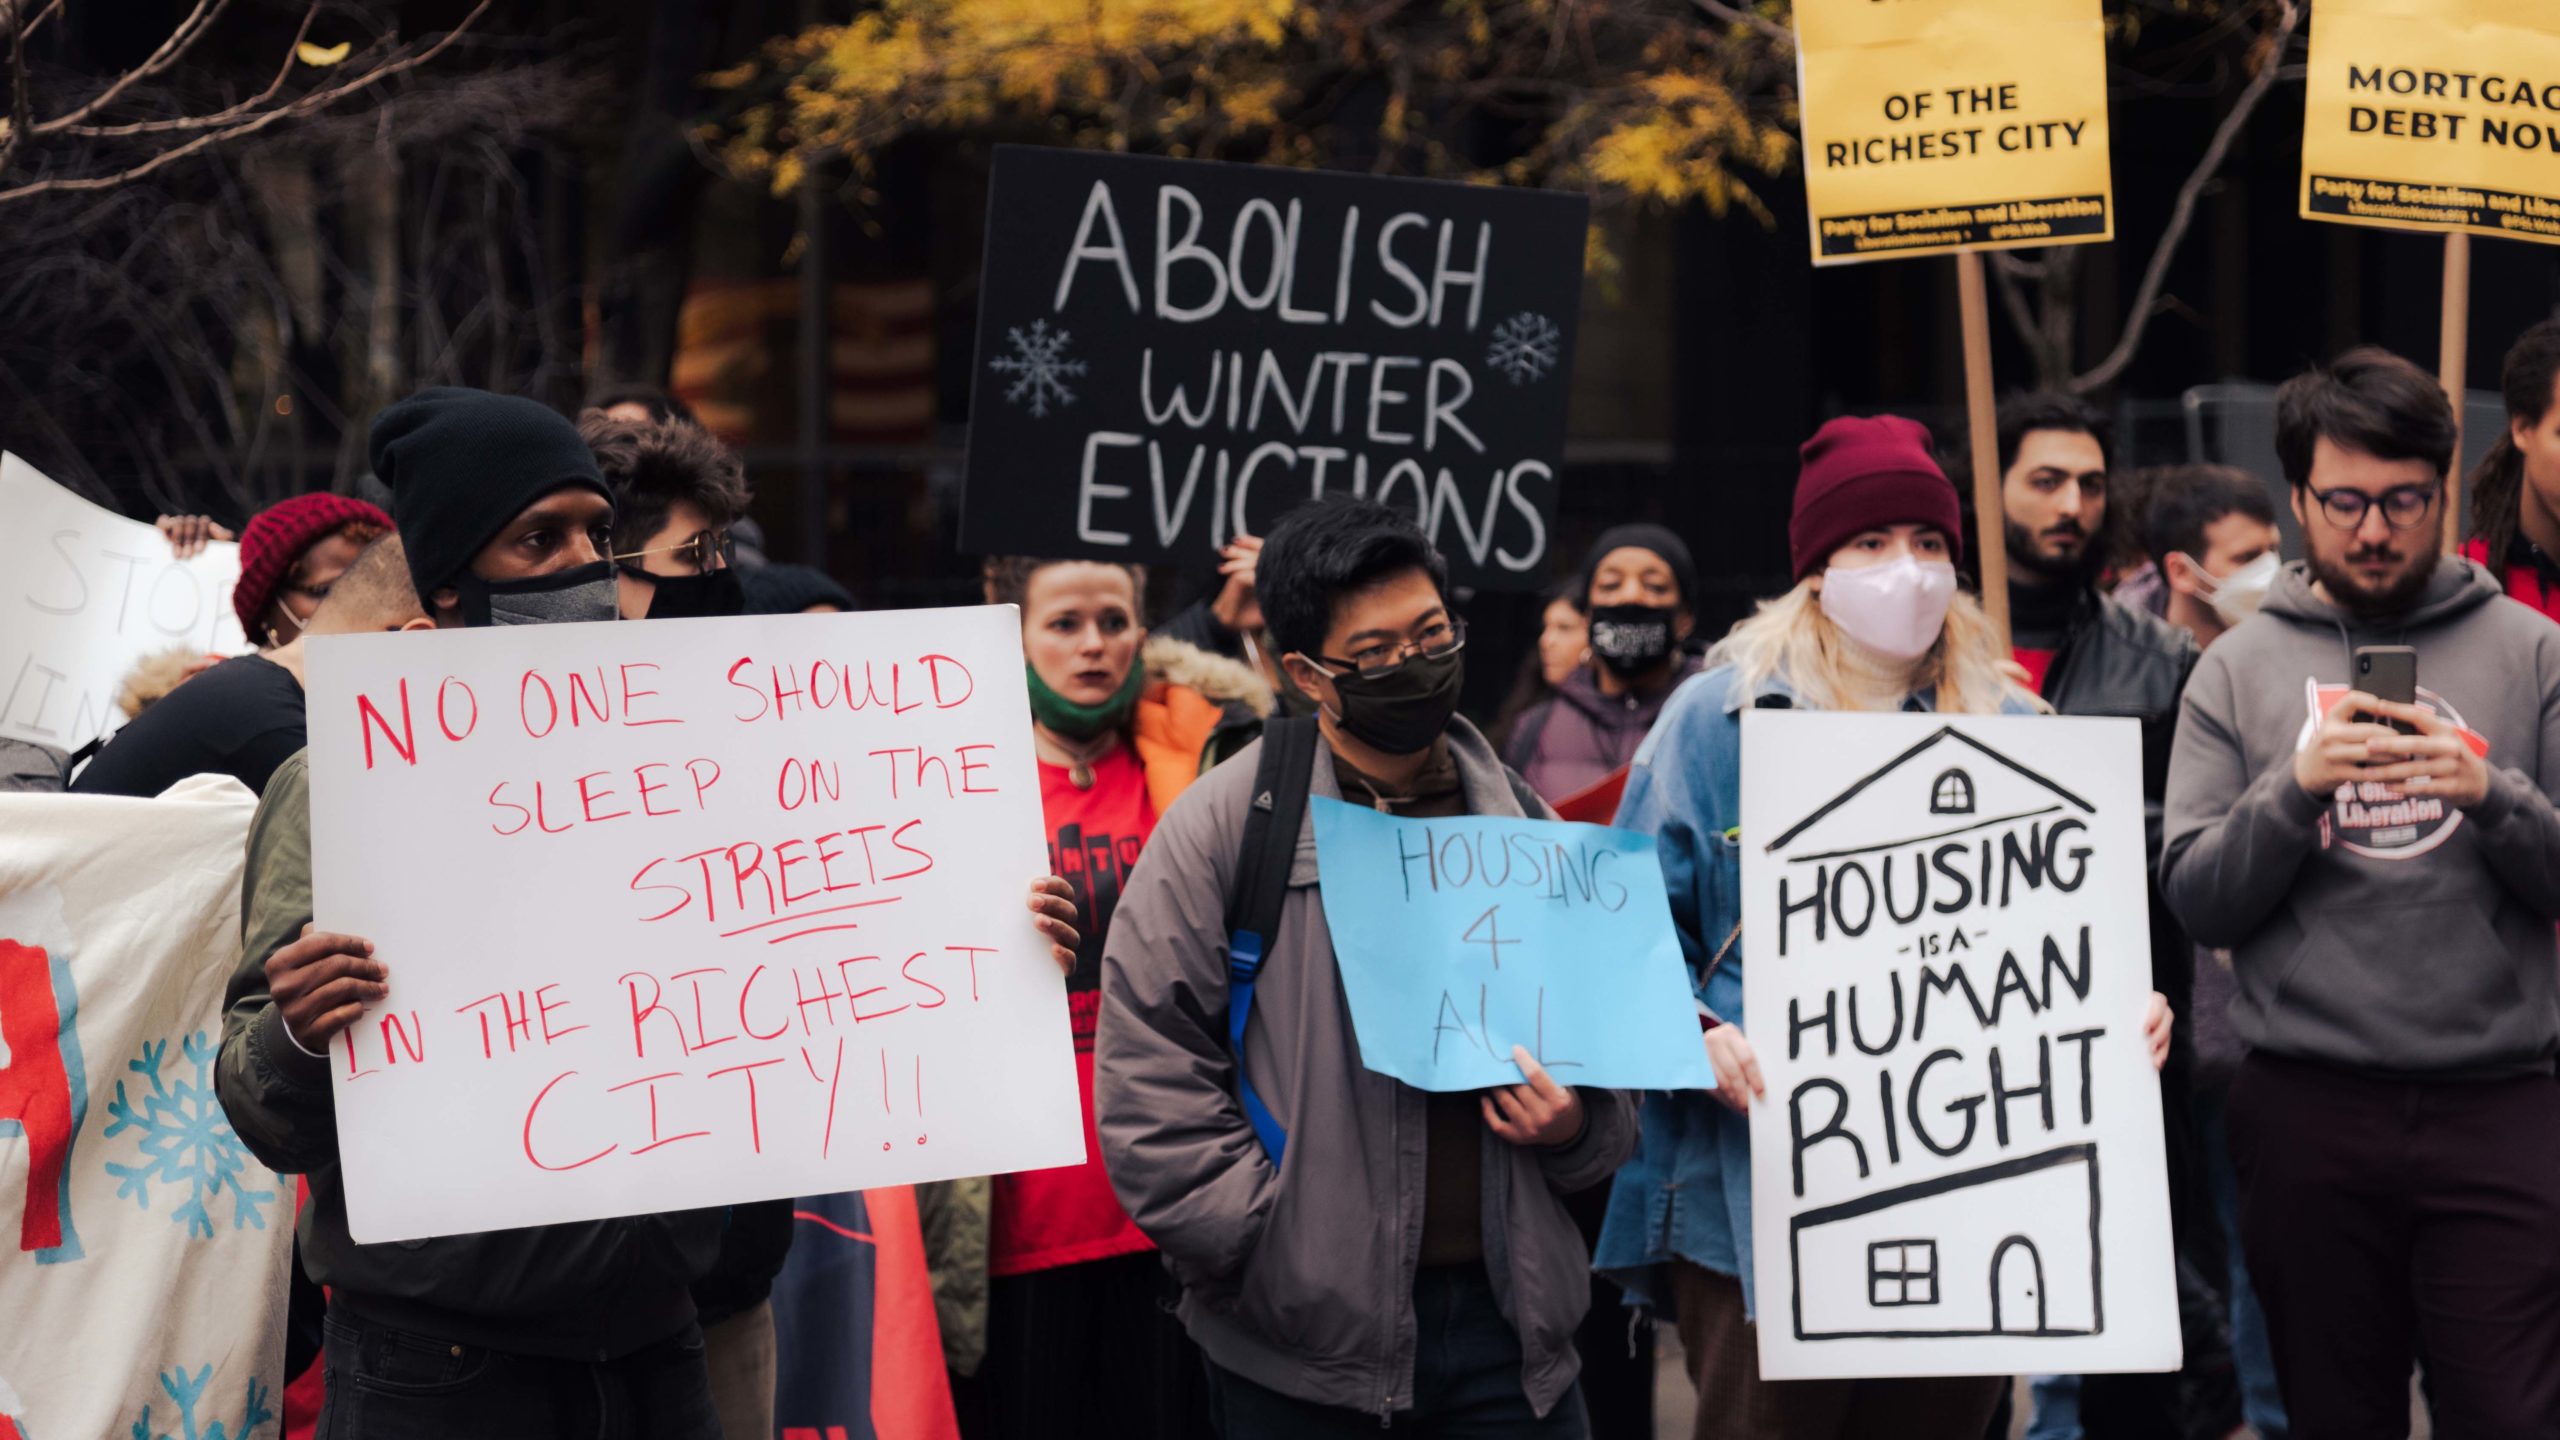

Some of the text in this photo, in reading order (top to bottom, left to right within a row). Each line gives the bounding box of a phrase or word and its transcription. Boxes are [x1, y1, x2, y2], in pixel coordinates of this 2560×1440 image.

[1826, 121, 2085, 167] RICHEST CITY
[1884, 84, 2018, 121] OF THE
[2350, 107, 2466, 140] DEBT
[1823, 198, 2102, 237] Party for Socialism and Liberation
[2314, 177, 2364, 201] Party
[2367, 181, 2395, 201] for
[2398, 184, 2485, 208] Socialism
[2488, 193, 2521, 213] and
[1055, 179, 1491, 331] ABOLISH
[1141, 347, 1486, 454] WINTER
[357, 655, 973, 771] NO ONE SHOULD
[489, 758, 720, 836] SLEEP
[779, 758, 839, 810] ON
[2337, 798, 2443, 828] Liberation
[630, 819, 934, 922] STREETS
[1398, 826, 1628, 912] HOUSING
[1779, 818, 2094, 957] HOUSING
[1462, 904, 1522, 970] 4
[343, 1008, 425, 1082] IN
[455, 983, 590, 1059] THE
[619, 946, 999, 1058] RICHEST
[1433, 983, 1584, 1068] ALL
[1789, 925, 2091, 1061] HUMAN
[523, 1036, 928, 1171] CITY!!
[1789, 1028, 2105, 1198] RIGHT
